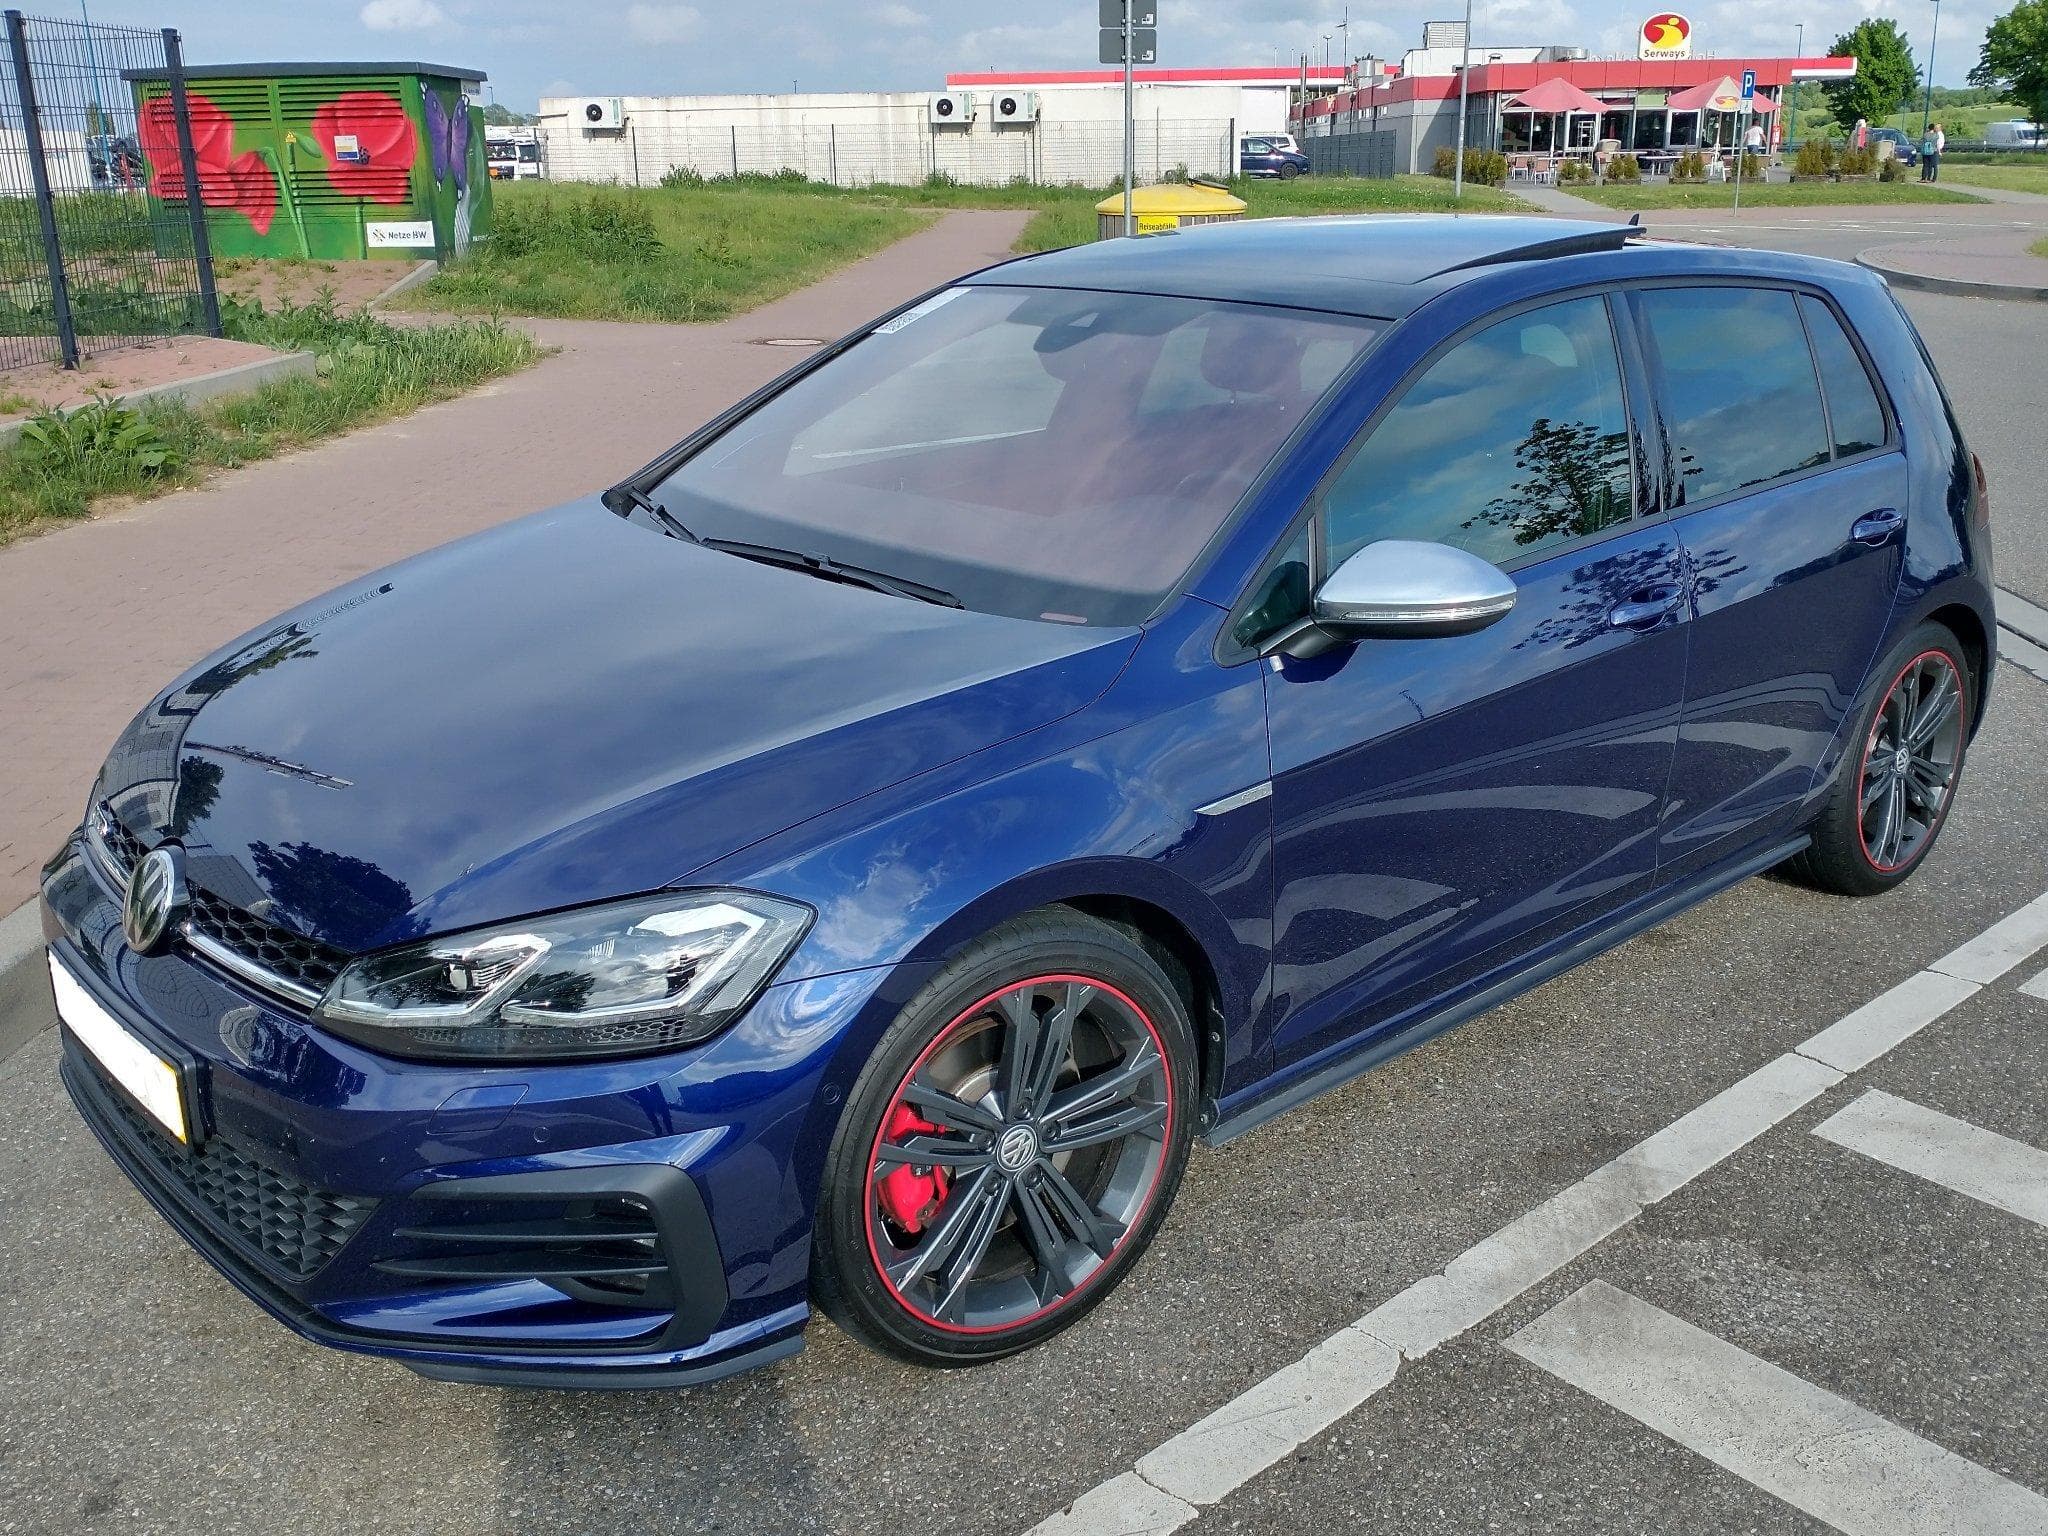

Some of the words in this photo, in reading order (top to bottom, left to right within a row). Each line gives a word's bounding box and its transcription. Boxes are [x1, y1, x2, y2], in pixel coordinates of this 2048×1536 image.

[1644, 49, 1685, 59] Serways
[1744, 74, 1752, 95] P
[1139, 222, 1177, 231] Reiseabfälle
[388, 231, 411, 239] Netze
[412, 230, 427, 239] BW
